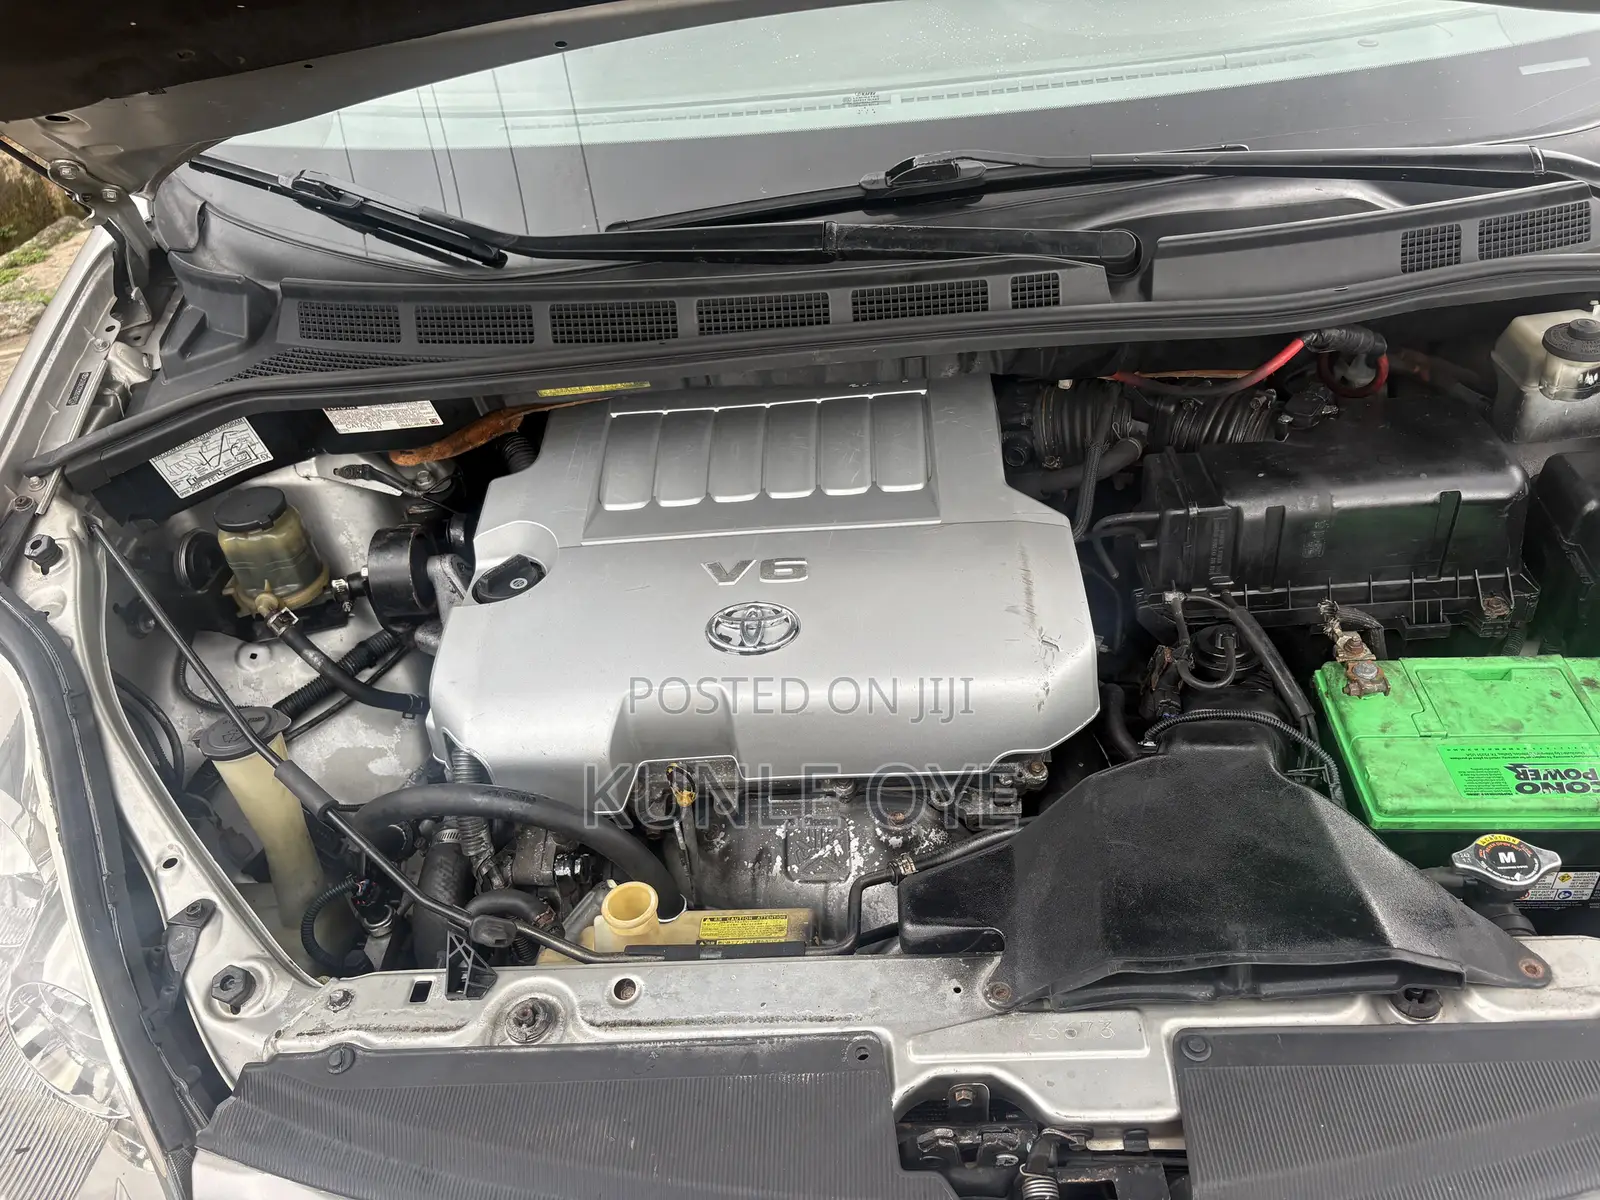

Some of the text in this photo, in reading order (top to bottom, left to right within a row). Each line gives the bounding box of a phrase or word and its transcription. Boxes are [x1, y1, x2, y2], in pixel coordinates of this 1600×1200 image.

[700, 558, 808, 585] V6
[1515, 768, 1599, 781] POWER
[1486, 834, 1516, 844] CAUTION
[1498, 851, 1517, 864] M
